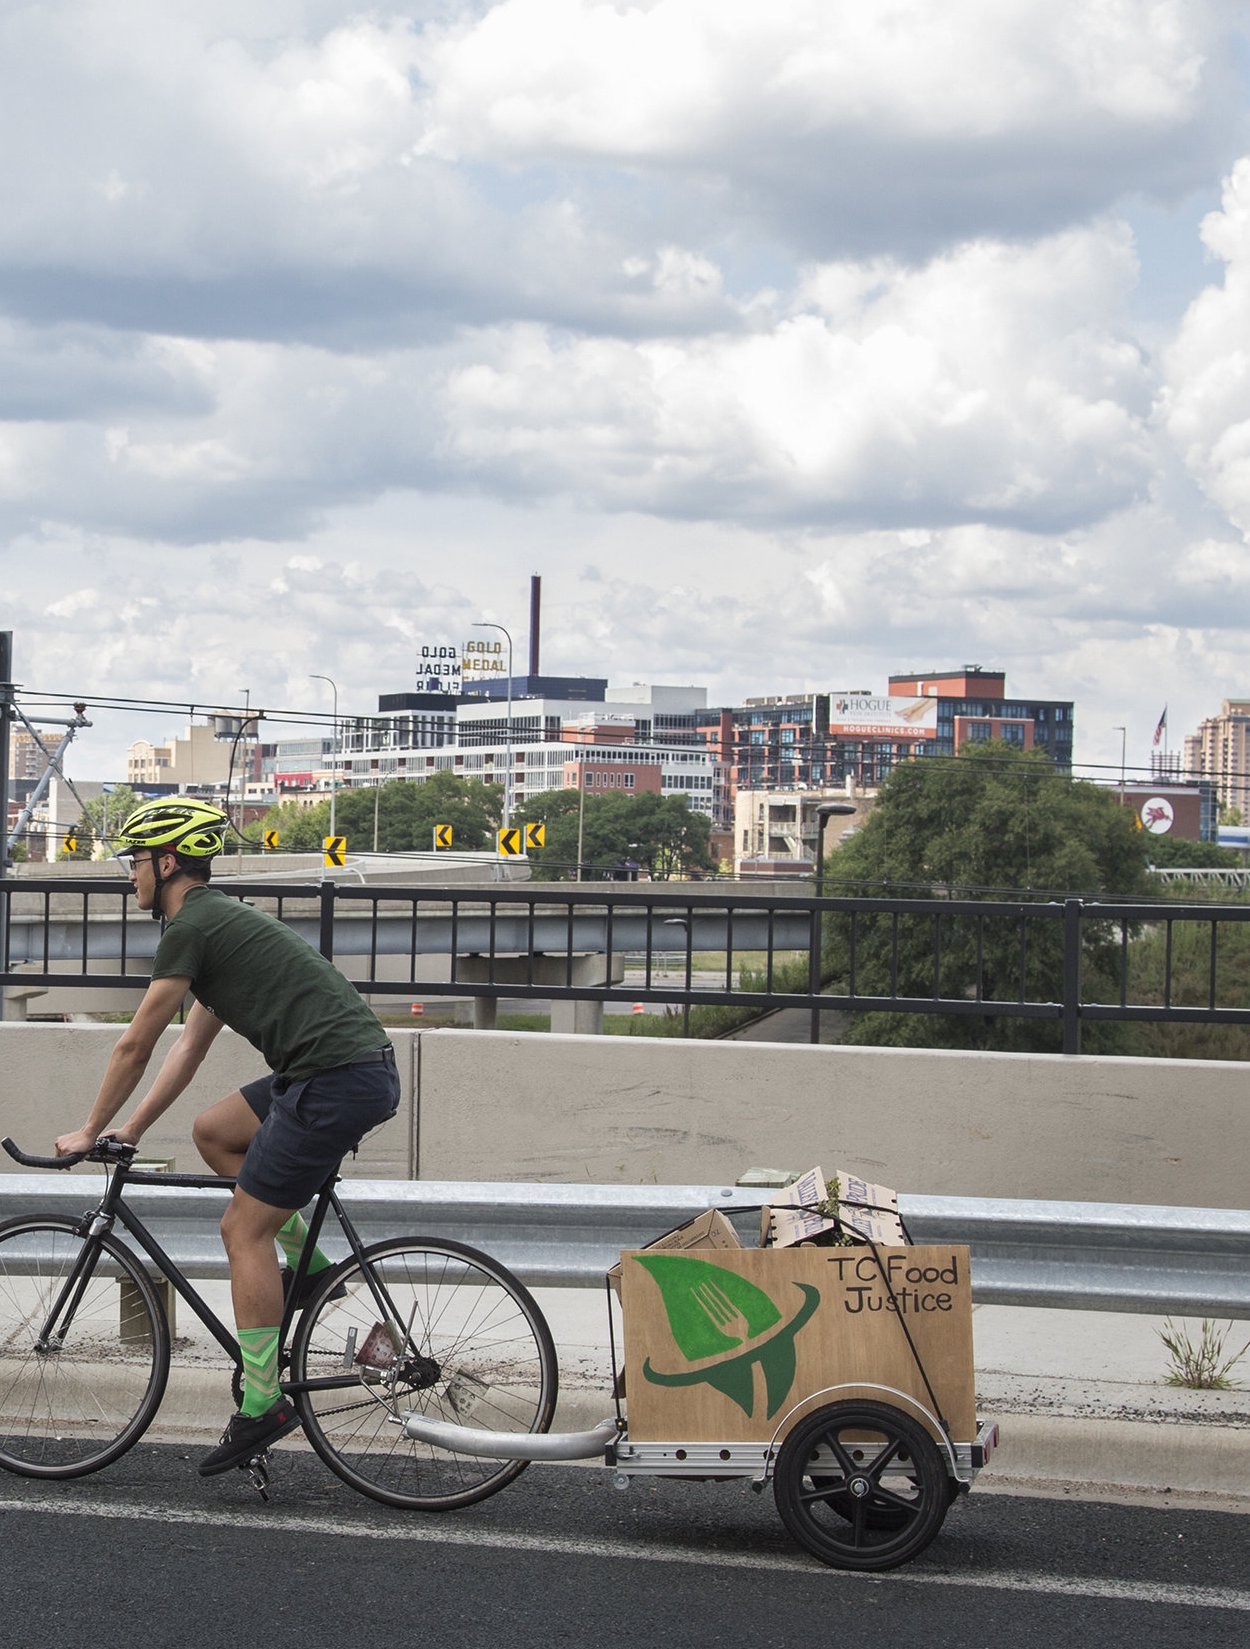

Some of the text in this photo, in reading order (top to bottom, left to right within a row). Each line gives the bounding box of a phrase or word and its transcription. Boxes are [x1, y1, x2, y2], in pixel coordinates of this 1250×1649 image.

[466, 641, 502, 654] GOLD
[462, 658, 507, 672] MEDAL
[850, 699, 891, 711] HOGUE
[843, 726, 925, 735] HOGUECLINICS.COM
[827, 1255, 959, 1285] TC Food
[844, 1286, 953, 1314] Justice
